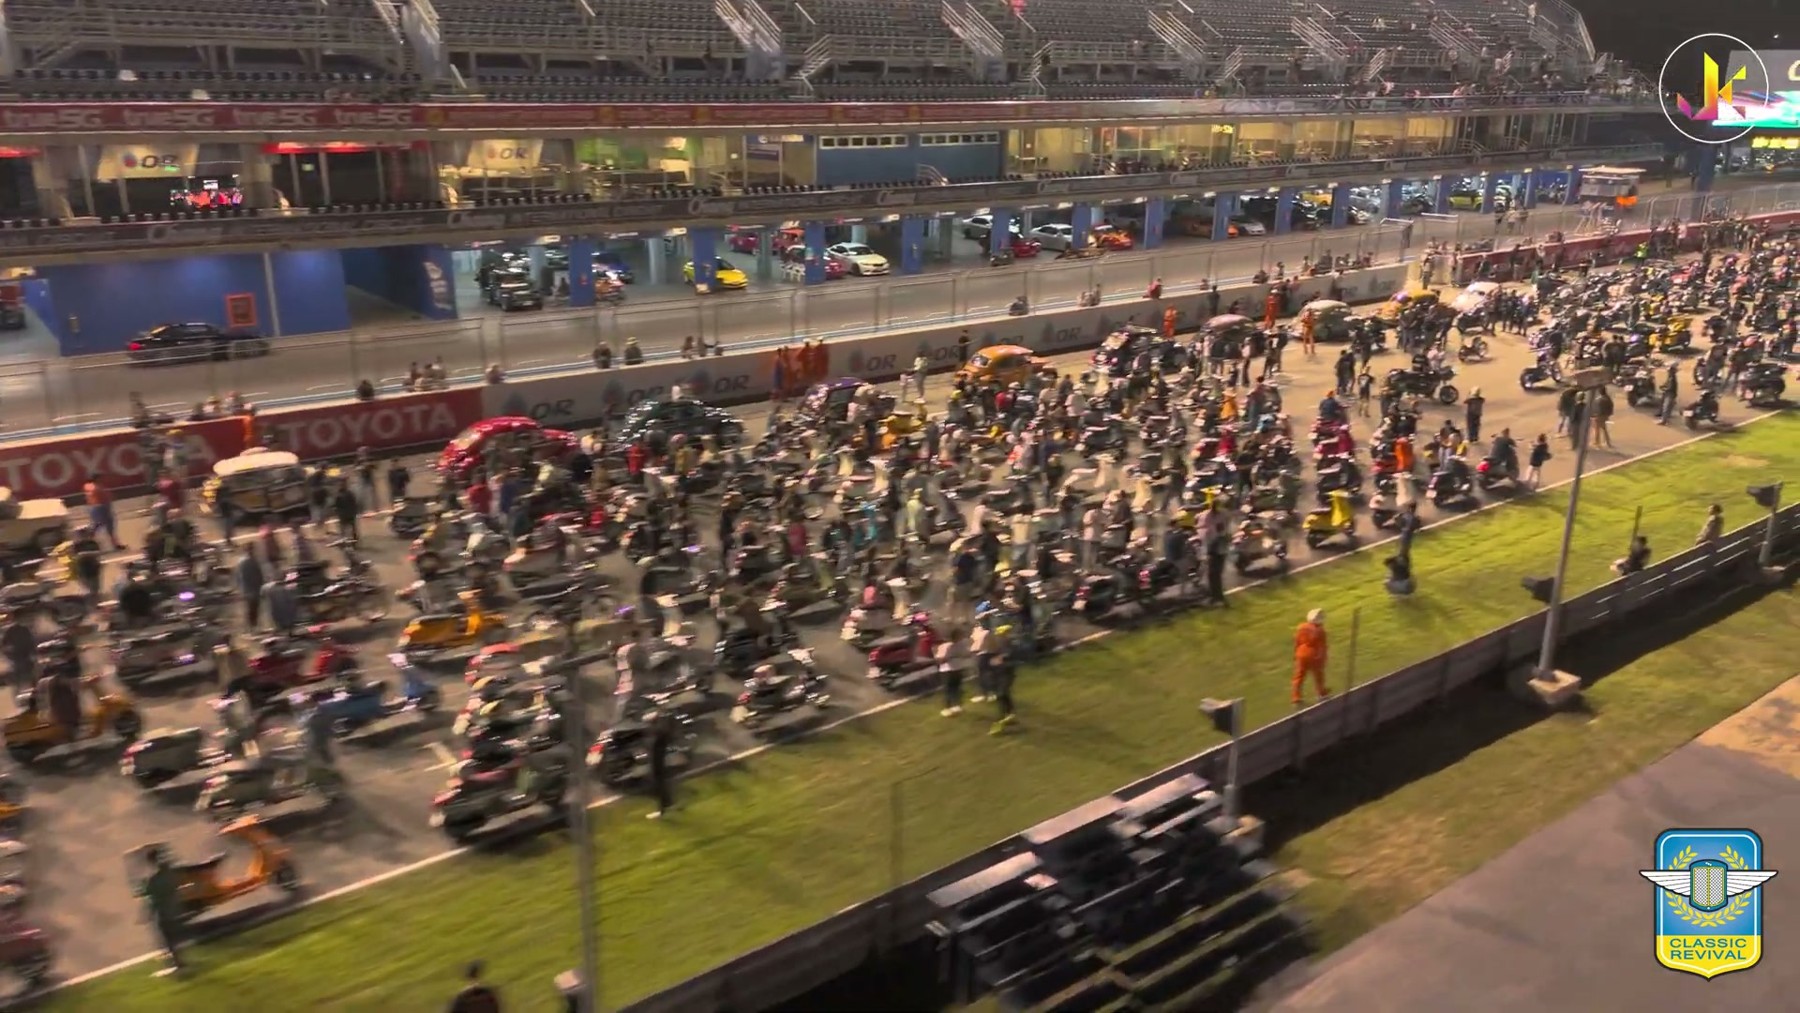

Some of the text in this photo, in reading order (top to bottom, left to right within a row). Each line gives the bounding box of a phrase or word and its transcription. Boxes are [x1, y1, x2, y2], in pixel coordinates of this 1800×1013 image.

[866, 354, 896, 371] OR
[714, 375, 749, 392] OR
[279, 403, 456, 450] TOYOTA
[0, 434, 215, 491] TOYOA
